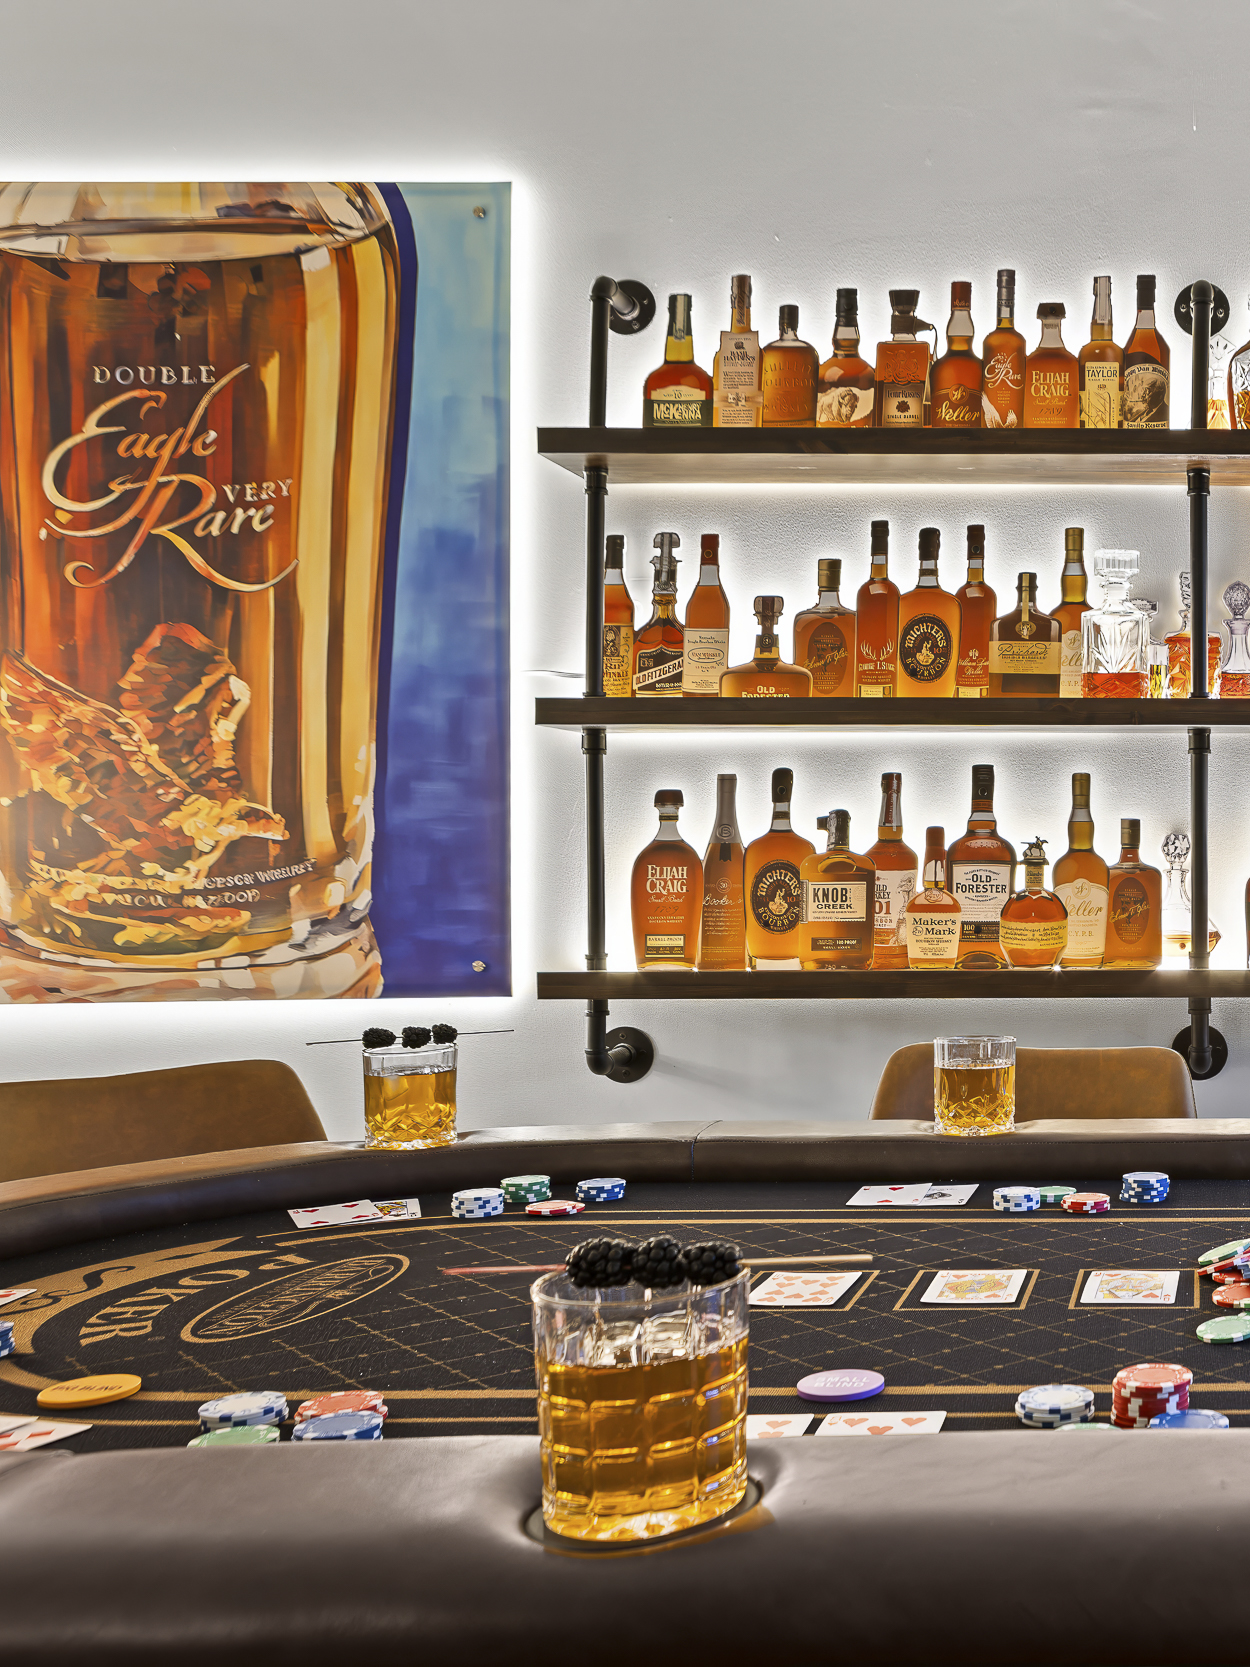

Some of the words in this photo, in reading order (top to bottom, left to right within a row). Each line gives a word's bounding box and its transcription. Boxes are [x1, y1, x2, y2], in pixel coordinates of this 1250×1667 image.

[984, 352, 1017, 381] Eagle
[1086, 370, 1118, 378] TAYLOR
[92, 365, 216, 385] DOUBLE
[988, 368, 1024, 389] Rare
[1032, 370, 1069, 386] ELIJAH
[1031, 384, 1069, 398] CRAIG
[936, 401, 980, 422] Weller
[42, 362, 250, 538] Eagle
[222, 478, 293, 504] VERY
[62, 473, 299, 592] Rare
[905, 622, 946, 648] MICHTER'S
[757, 686, 775, 694] OLD
[647, 864, 688, 880] ELIJAH
[972, 874, 992, 882] OLD
[646, 878, 687, 894] CRAIG
[757, 869, 800, 896] MICHTER'S
[876, 884, 888, 892] ILD
[956, 883, 1006, 894] FORESTER
[812, 888, 848, 903] KNOB
[876, 900, 892, 914] 01
[758, 907, 800, 926] BOURBON
[912, 918, 956, 926] Maker's
[924, 927, 956, 936] Mark
[79, 1253, 318, 1347] POKER
